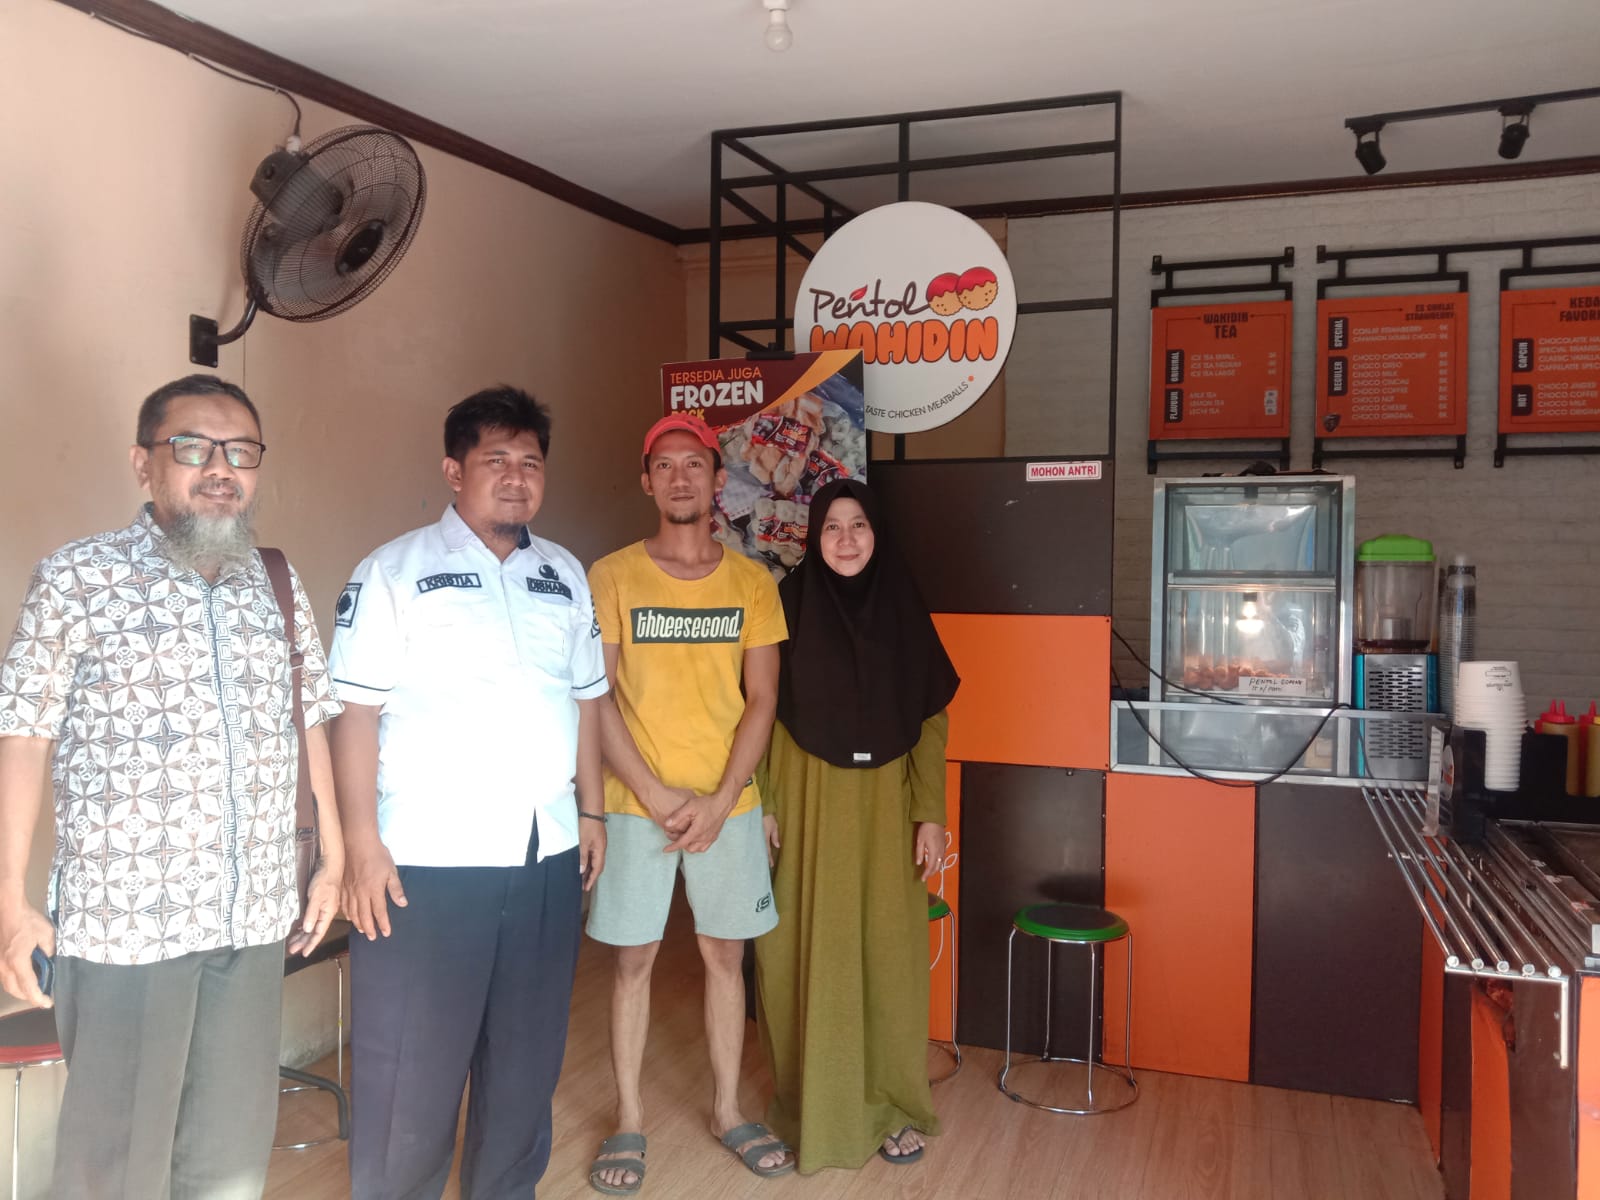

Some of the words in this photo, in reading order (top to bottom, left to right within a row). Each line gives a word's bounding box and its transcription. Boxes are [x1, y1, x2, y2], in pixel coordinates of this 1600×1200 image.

[810, 279, 931, 322] Pentol
[810, 316, 998, 365] WAHIDIN
[1214, 325, 1237, 339] TEA
[1334, 320, 1343, 348] SPECIAL
[670, 371, 724, 384] TERSEDIA
[728, 366, 762, 382] JUGA
[1171, 352, 1180, 382] ORIGINAL
[1334, 361, 1342, 391] REGULER
[670, 380, 764, 409] FROZEN
[865, 405, 886, 417] TASTE
[888, 406, 926, 419] CHICKEN
[927, 381, 969, 413] MEATBALLS
[1170, 391, 1178, 420] FLAVOUR
[1518, 394, 1527, 407] HOT
[1031, 466, 1065, 477] MOHON
[1068, 465, 1097, 476] ANTRI
